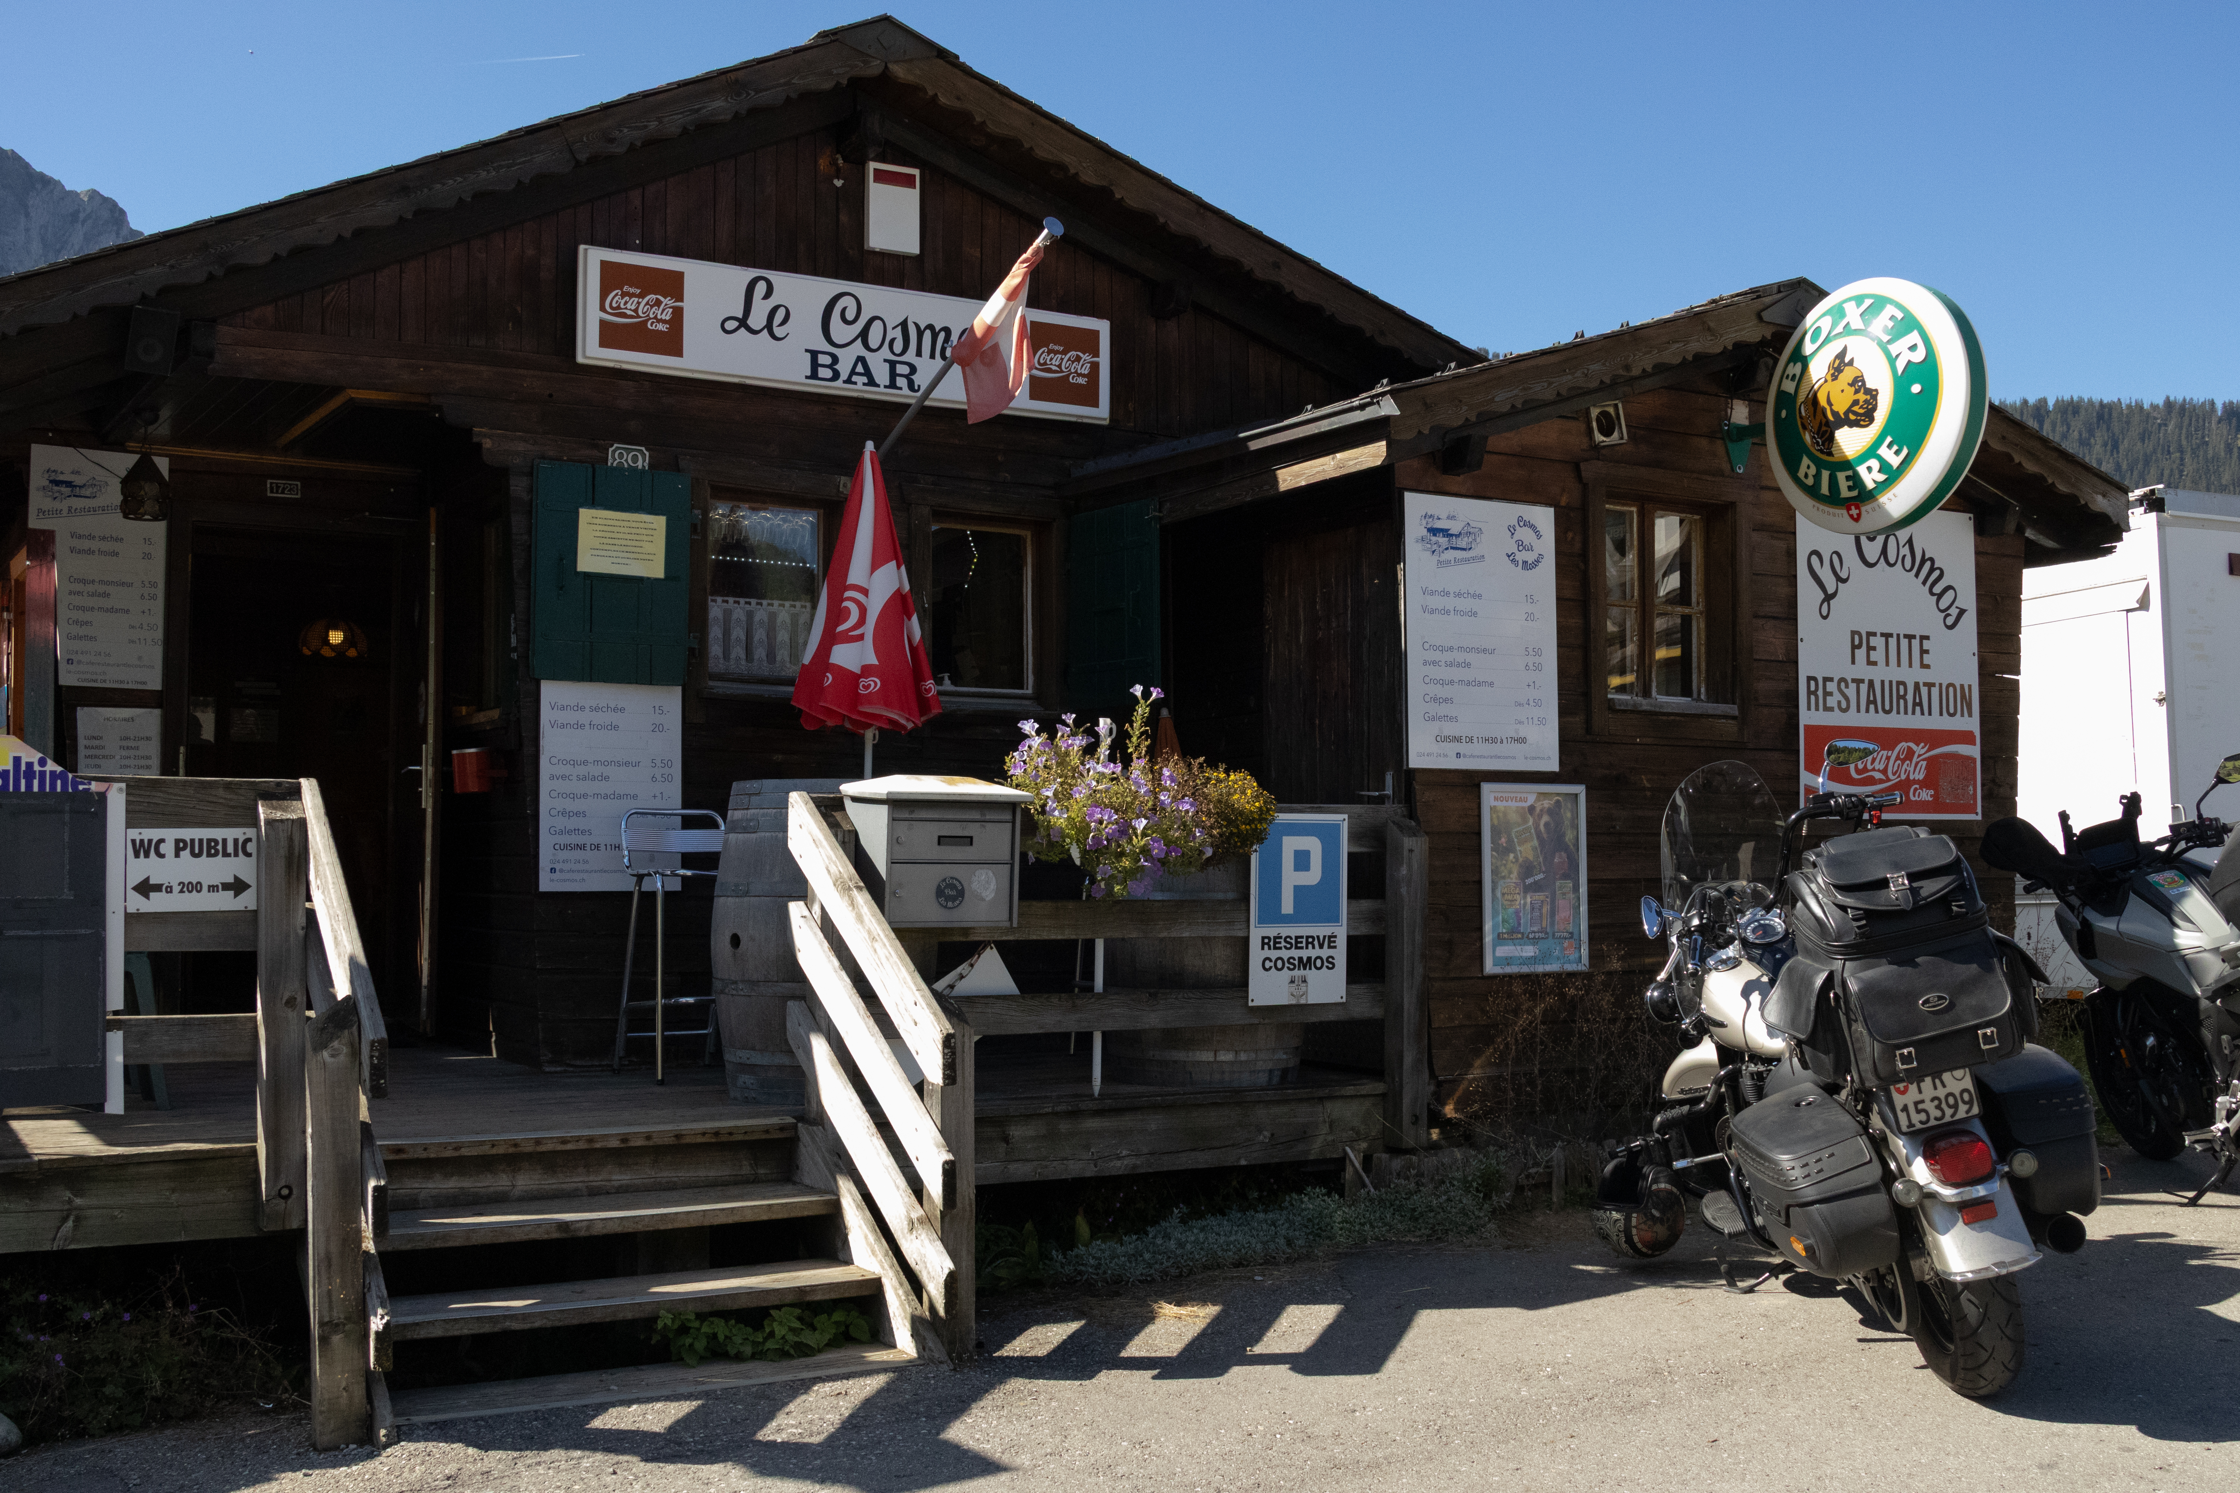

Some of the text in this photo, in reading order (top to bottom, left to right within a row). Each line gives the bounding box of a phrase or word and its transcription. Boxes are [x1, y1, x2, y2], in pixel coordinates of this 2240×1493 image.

[623, 286, 641, 294] Enjoy
[605, 290, 675, 320] Coca-Cola
[720, 275, 791, 342] Le
[647, 320, 670, 331] Coke
[1780, 298, 1927, 396] BOXER
[1034, 348, 1093, 374] Coca-Cola
[804, 349, 921, 393] BAR
[1069, 374, 1088, 384] Coke
[613, 450, 643, 470] 89
[1796, 436, 1909, 498] BIERE
[272, 484, 297, 494] 1723
[36, 507, 63, 517] Petite
[1812, 492, 1898, 519] PRODUIT SUISSE
[1507, 516, 1543, 540] Le Cosmos
[70, 531, 96, 541] Viande
[98, 534, 124, 543] séchée
[1515, 540, 1534, 552] Bar
[70, 546, 156, 560] Viande froide 20.-
[1436, 554, 1485, 567] Petite Restauration
[1506, 552, 1519, 568] Les
[68, 576, 158, 589] Croque-monsieur 5.50
[1806, 549, 1850, 620] Le
[68, 589, 158, 601] avec salade 6.50
[1421, 586, 1539, 604] Viande séchée 15.-
[68, 603, 130, 614] Croque-madame
[1422, 605, 1539, 622] Viande froide 20.-
[67, 618, 93, 628] Crêpes
[66, 632, 98, 642] Galettes
[1422, 641, 1542, 657] Croque-monsieur 5.50
[1850, 630, 1931, 669] PETITE
[1422, 659, 1542, 672] avec salade 6.50
[1422, 675, 1495, 688] Croque-madame
[1423, 694, 1454, 706] Crêpes
[1526, 698, 1542, 708] 4.50
[1806, 676, 1973, 718] RESTAURATION
[550, 702, 670, 715] Viande séchée 15.-
[1424, 712, 1459, 723] Galettes
[1526, 717, 1547, 726] 11.50
[549, 720, 670, 733] Viande froide 20.-
[1435, 735, 1463, 744] CUISINE
[1465, 736, 1474, 744] DE
[1476, 736, 1498, 744] 11H30
[1506, 736, 1527, 745] 17H00
[549, 756, 673, 768] Croque-monsieur 5.50
[549, 772, 673, 783] avec salade 6.50
[549, 790, 638, 801] Croque-madame
[1910, 785, 1934, 801] Coke
[549, 808, 587, 819] Crêpes
[548, 826, 592, 836] Galettes
[130, 838, 253, 859] WC PUBLIC
[553, 843, 588, 851] CUISINE
[590, 843, 601, 851] DE
[1282, 836, 1322, 914] P
[164, 881, 220, 894] à 200 m
[1261, 932, 1337, 951] RÉSERVÉ
[1262, 956, 1336, 972] COSMOS
[1900, 1088, 1975, 1129] 15399
